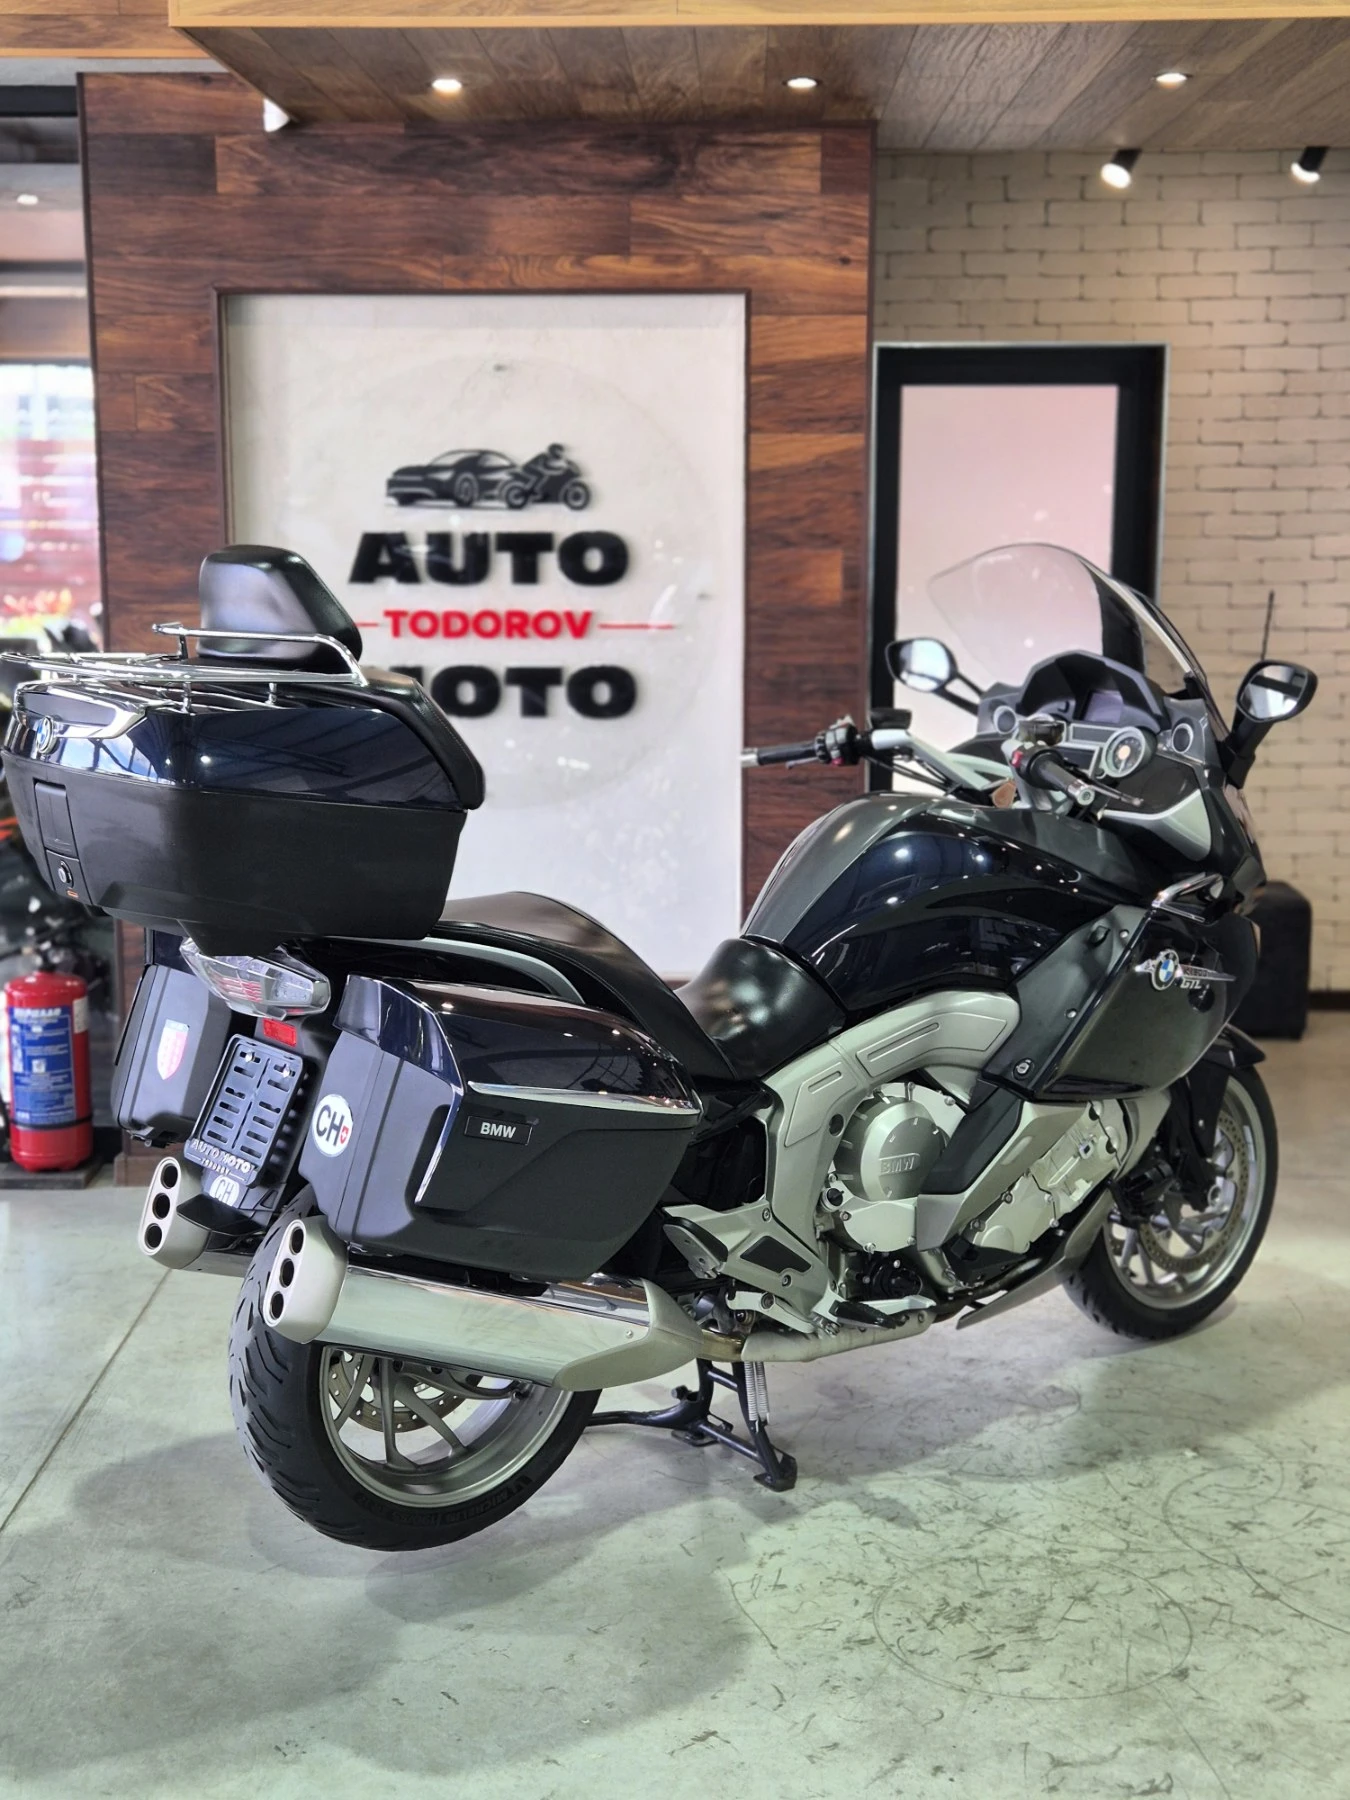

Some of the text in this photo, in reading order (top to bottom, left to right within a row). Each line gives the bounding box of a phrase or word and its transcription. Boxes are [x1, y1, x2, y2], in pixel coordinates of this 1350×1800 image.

[348, 531, 629, 586] AUTO
[383, 609, 593, 640] TODOROV
[1180, 978, 1202, 989] GTL
[316, 1104, 345, 1147] CH
[480, 1121, 517, 1139] BMW
[191, 1139, 220, 1158] AUTO
[881, 1156, 915, 1174] BMW
